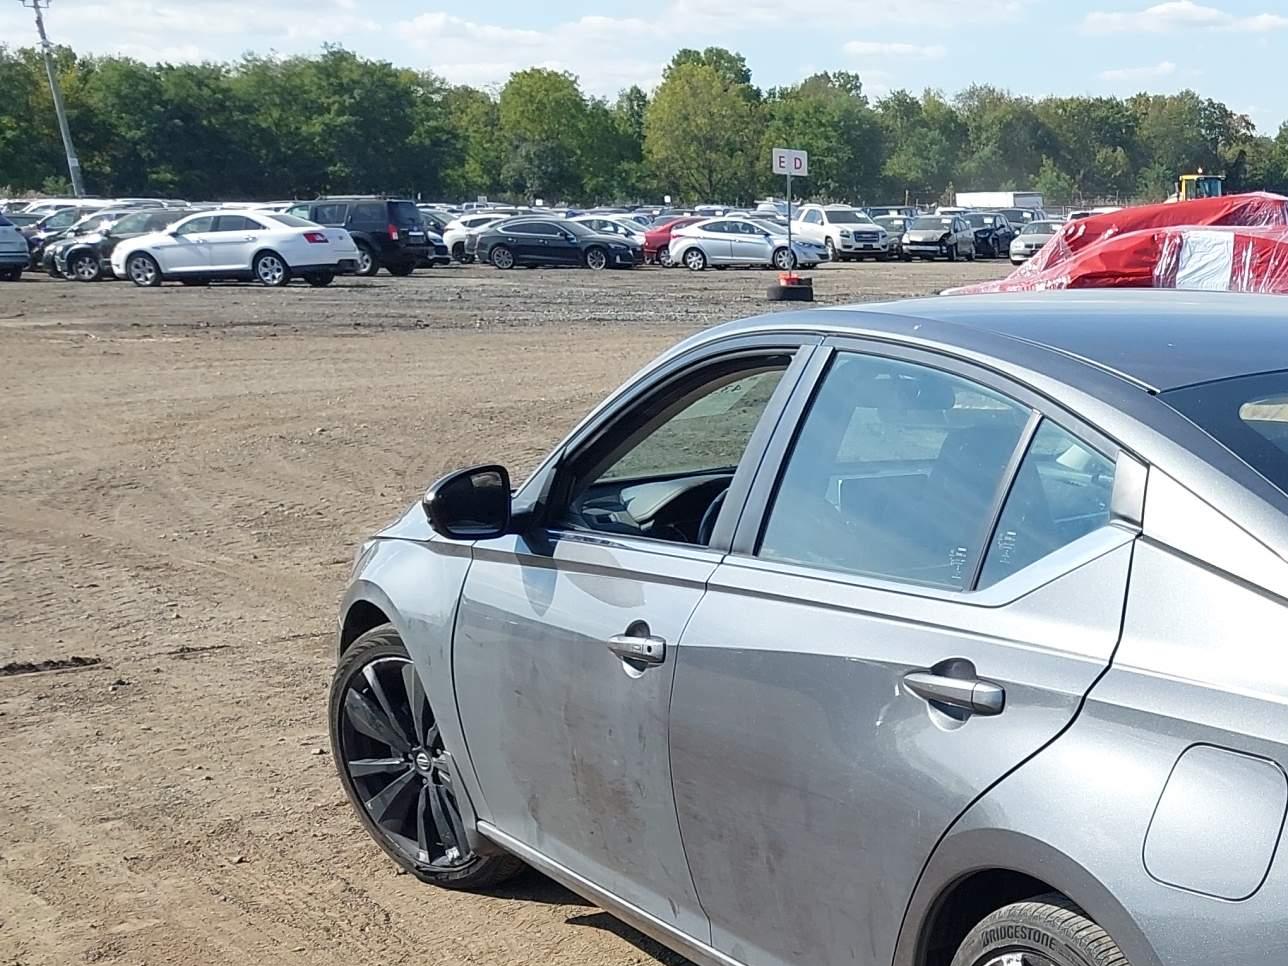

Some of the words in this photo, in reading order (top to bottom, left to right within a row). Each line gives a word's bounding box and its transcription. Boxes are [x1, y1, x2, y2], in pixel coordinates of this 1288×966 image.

[779, 155, 786, 169] E
[794, 156, 803, 170] D
[981, 925, 1057, 951] BRIDGESTONE
